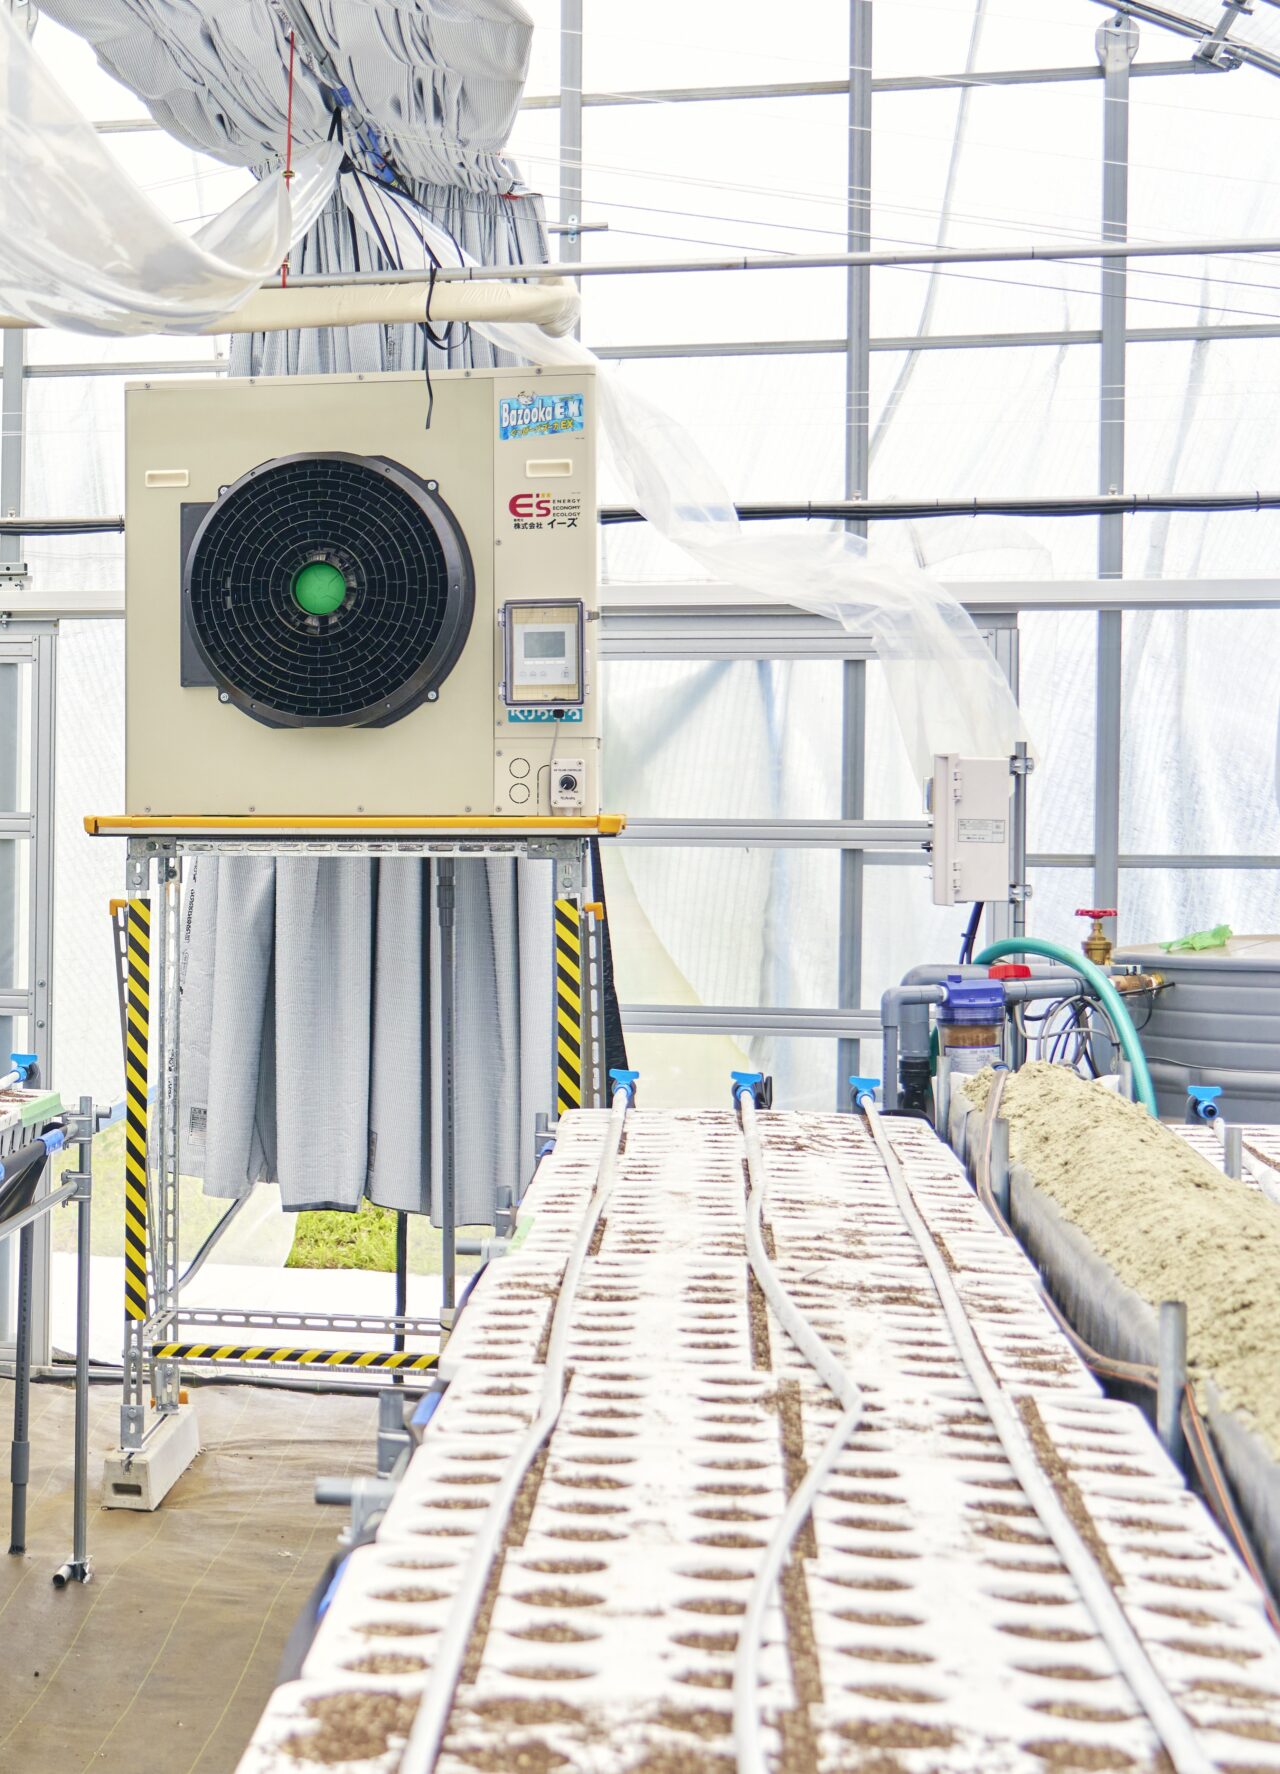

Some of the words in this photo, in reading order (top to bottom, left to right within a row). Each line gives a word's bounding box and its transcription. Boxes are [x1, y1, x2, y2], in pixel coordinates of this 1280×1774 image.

[502, 399, 553, 428] Bazooka
[547, 517, 578, 528] イーズ
